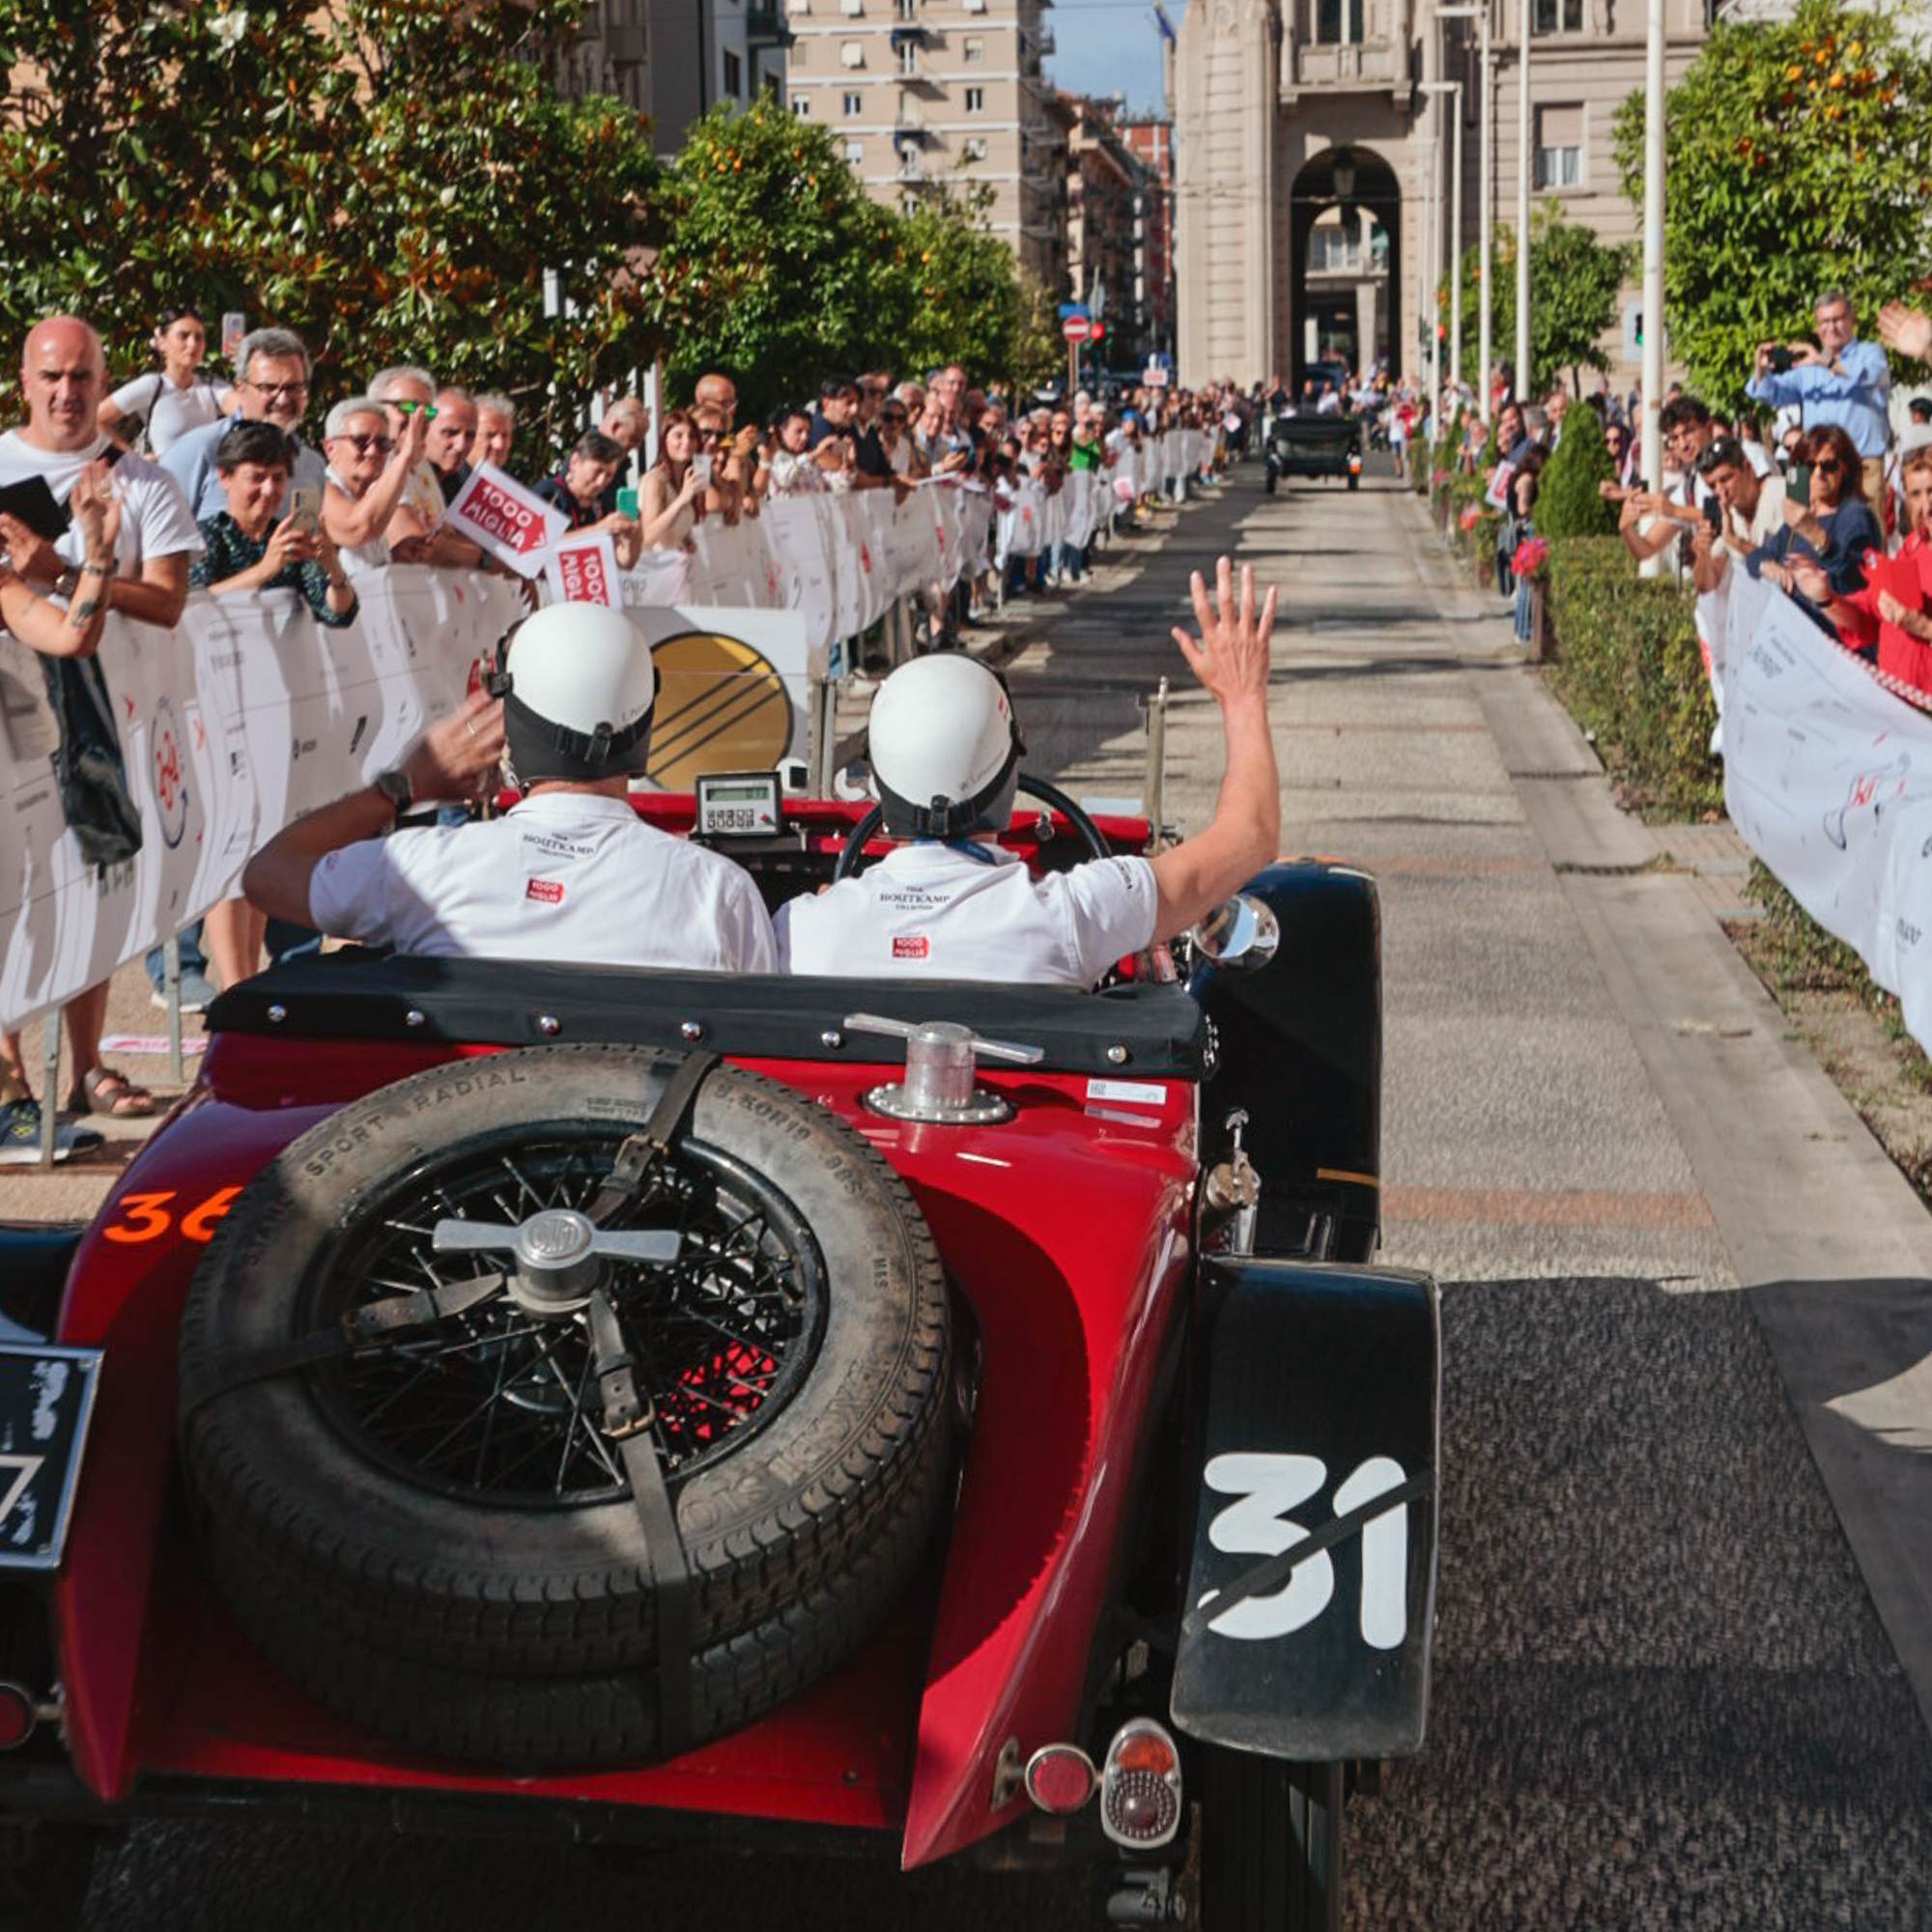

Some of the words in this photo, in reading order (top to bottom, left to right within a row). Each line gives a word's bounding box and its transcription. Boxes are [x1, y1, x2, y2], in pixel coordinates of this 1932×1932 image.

[465, 501, 526, 549] MIGLIA
[482, 484, 532, 527] 1000
[880, 893, 951, 904] HOUTKAMP
[896, 938, 924, 947] 1000
[303, 1115, 385, 1179] SPORT
[412, 1067, 527, 1112] RADIAL
[679, 1357, 894, 1534] EXCELSIO
[1197, 1452, 1408, 1650] 31
